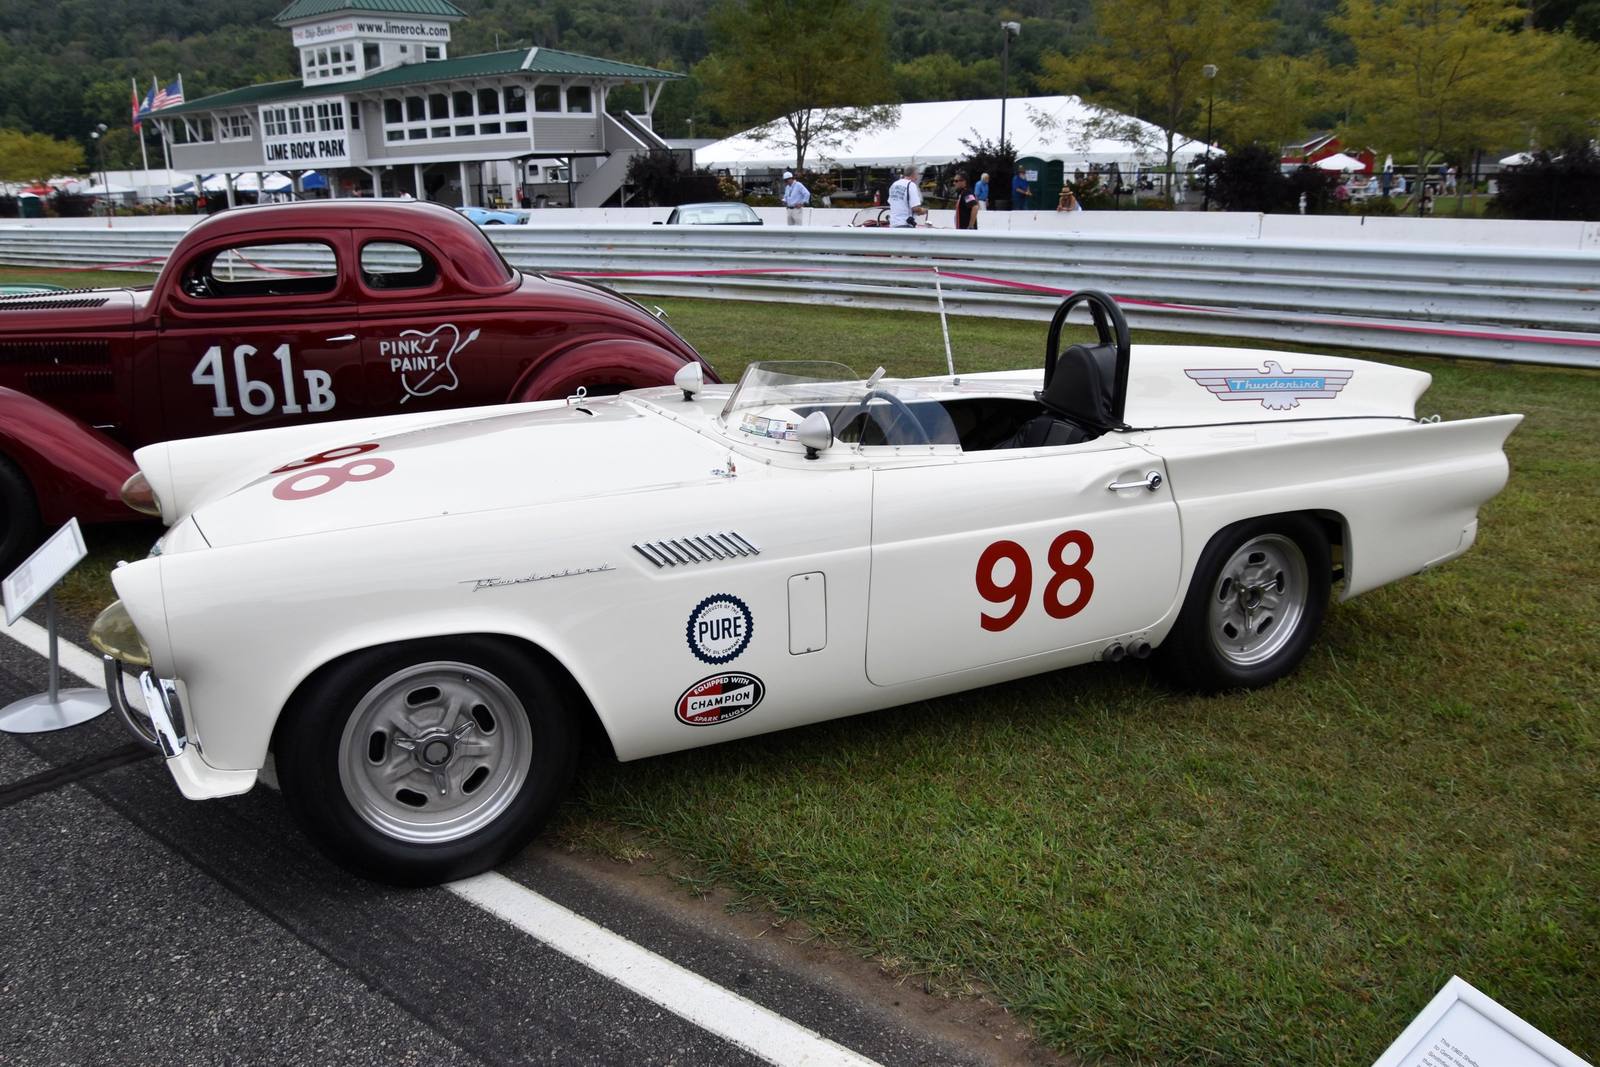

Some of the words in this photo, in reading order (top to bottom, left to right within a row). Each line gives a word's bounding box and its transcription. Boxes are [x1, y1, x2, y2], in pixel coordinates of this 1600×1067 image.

[356, 21, 449, 37] www.limerock.com
[266, 144, 289, 161] LIME
[289, 141, 317, 160] ROCK
[318, 139, 346, 157] PARK
[379, 337, 440, 356] PINK'S
[390, 355, 439, 373] PAINT
[1230, 380, 1321, 390] Thunderbird
[975, 529, 1095, 633] 98
[698, 616, 742, 643] PURE
[693, 677, 729, 695] EQUIPPED
[730, 676, 750, 685] WITH
[691, 691, 750, 711] CHAMPION
[694, 715, 718, 723] SPARK
[720, 706, 746, 720] PLUGS
